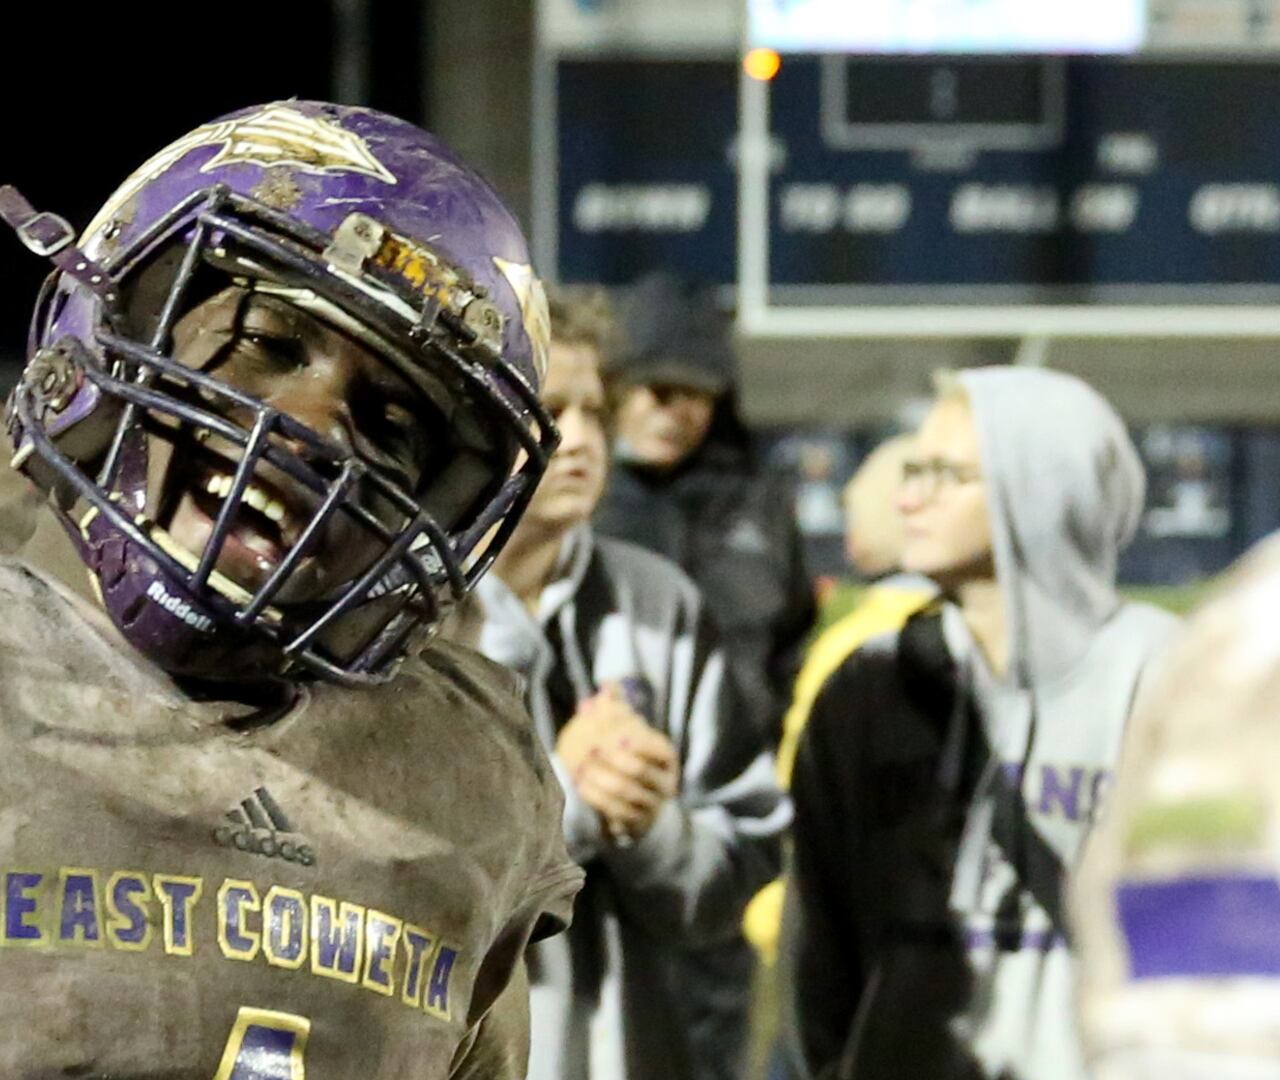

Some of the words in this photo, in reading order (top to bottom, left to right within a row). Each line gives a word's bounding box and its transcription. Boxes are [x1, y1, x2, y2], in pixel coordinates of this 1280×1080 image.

[146, 580, 213, 633] Riddell
[211, 822, 317, 867] adidas
[216, 876, 463, 1022] COWETA
